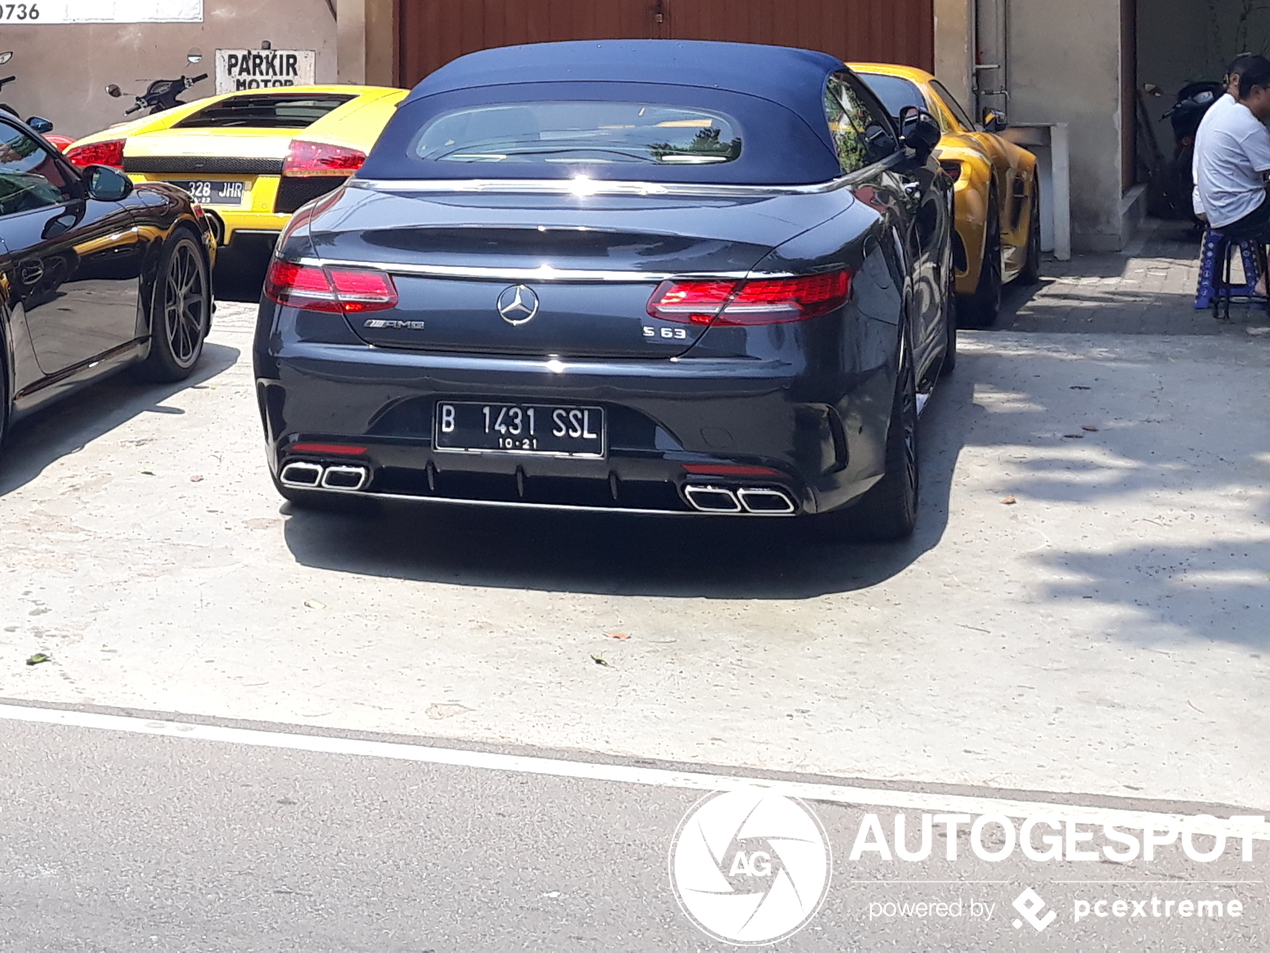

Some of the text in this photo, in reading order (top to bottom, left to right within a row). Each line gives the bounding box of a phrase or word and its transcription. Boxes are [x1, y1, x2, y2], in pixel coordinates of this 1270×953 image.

[227, 53, 298, 76] PARKIR
[219, 182, 243, 197] JHR
[642, 325, 687, 339] S 63
[441, 404, 598, 439] B 1431 SSL
